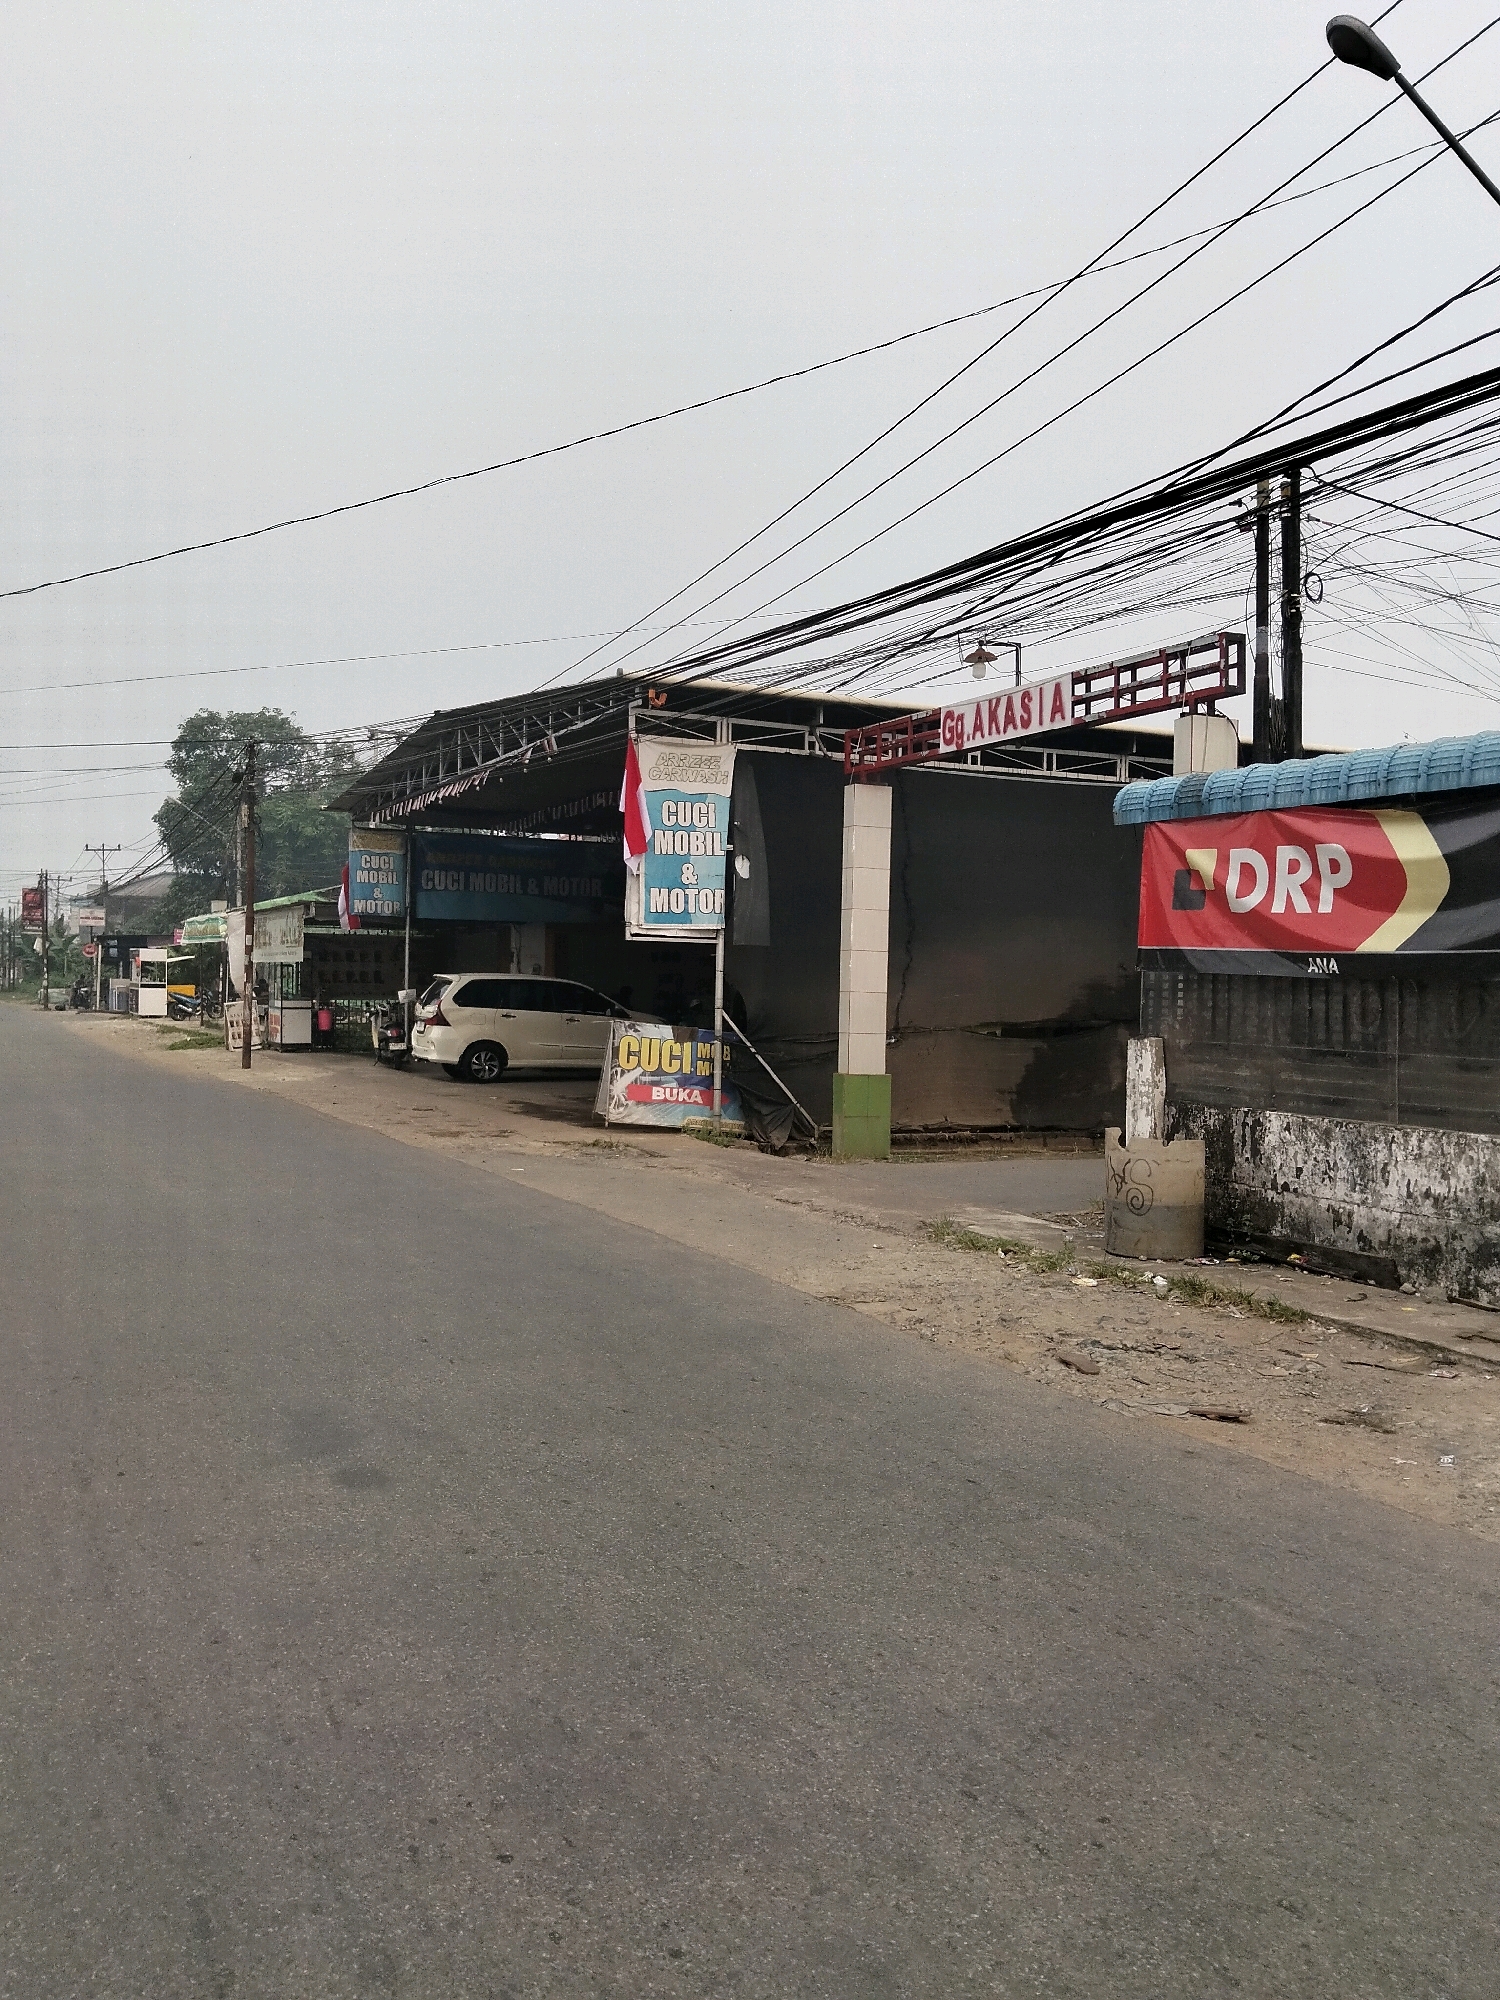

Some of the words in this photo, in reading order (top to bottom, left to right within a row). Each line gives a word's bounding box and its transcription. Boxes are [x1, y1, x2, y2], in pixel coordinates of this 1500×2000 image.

[649, 767, 729, 785] CARWASH
[661, 800, 717, 829] CUCI
[653, 829, 726, 857] MOBIL
[361, 854, 394, 870] CUCI
[356, 870, 399, 885] MOBIL
[421, 869, 465, 891] CUCI
[469, 871, 524, 895] MOBIL
[526, 877, 540, 895] &
[543, 875, 603, 898] MOTOR
[680, 863, 699, 885] &
[1226, 843, 1352, 914] DRP
[373, 887, 383, 899] &
[1307, 957, 1339, 974] ANA
[618, 1034, 692, 1075] CUCI
[651, 1086, 704, 1105] BUKA
